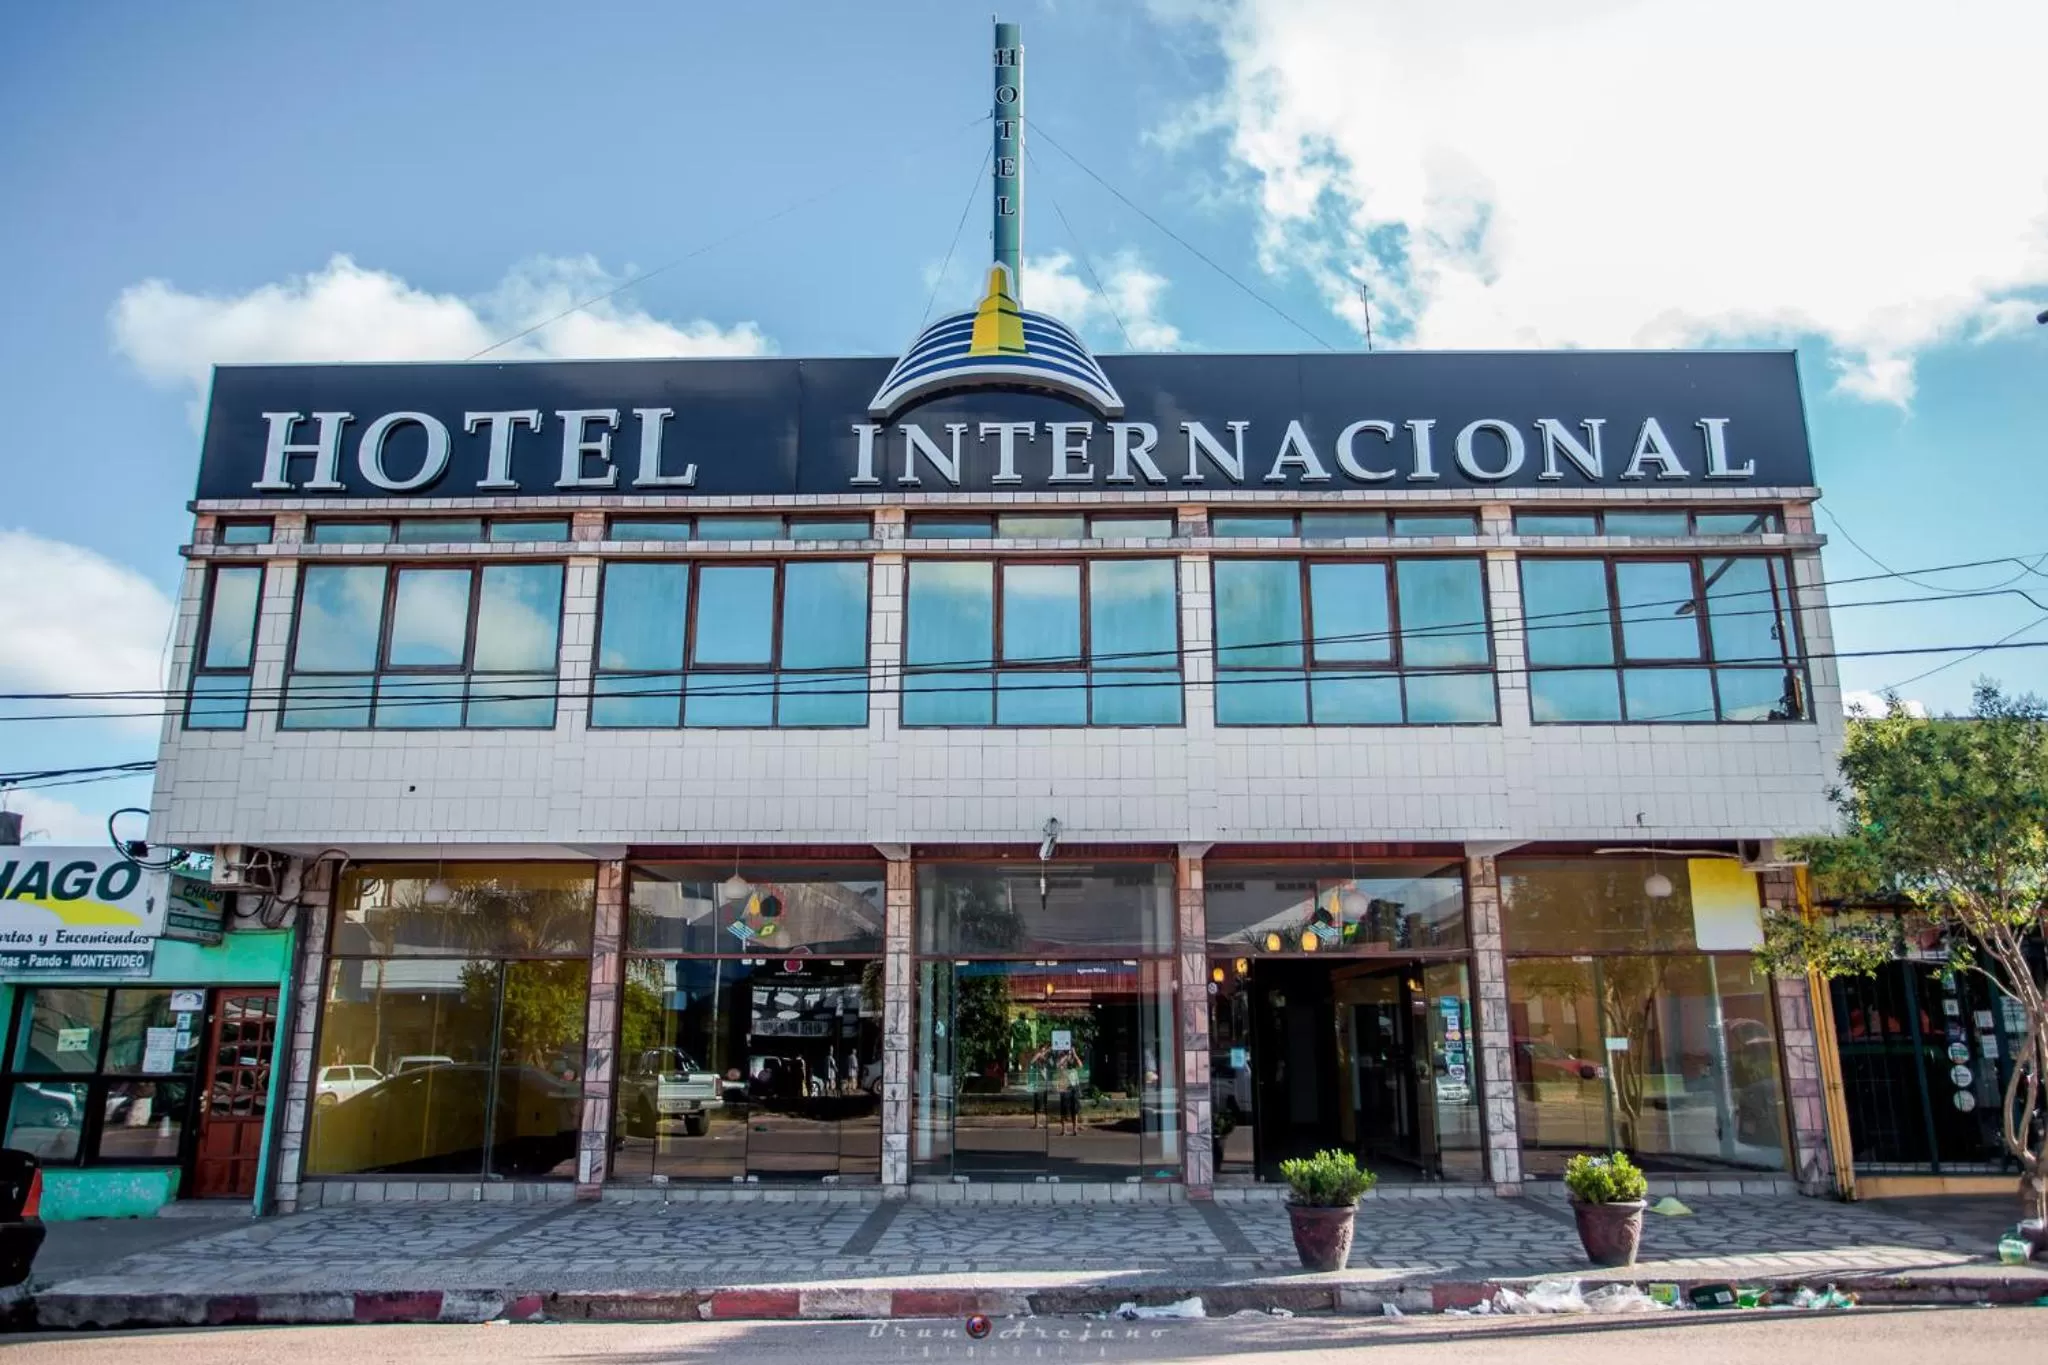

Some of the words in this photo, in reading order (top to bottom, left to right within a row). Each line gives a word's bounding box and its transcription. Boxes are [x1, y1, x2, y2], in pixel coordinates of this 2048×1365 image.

[993, 48, 1019, 216] HOTEL
[252, 408, 698, 491] HOTEL
[850, 417, 1756, 486] INTERNACIONAL
[29, 954, 62, 967] Pando
[70, 954, 145, 967] MONTEVIDEO
[39, 933, 48, 947] y
[56, 929, 150, 945] Encomiendas
